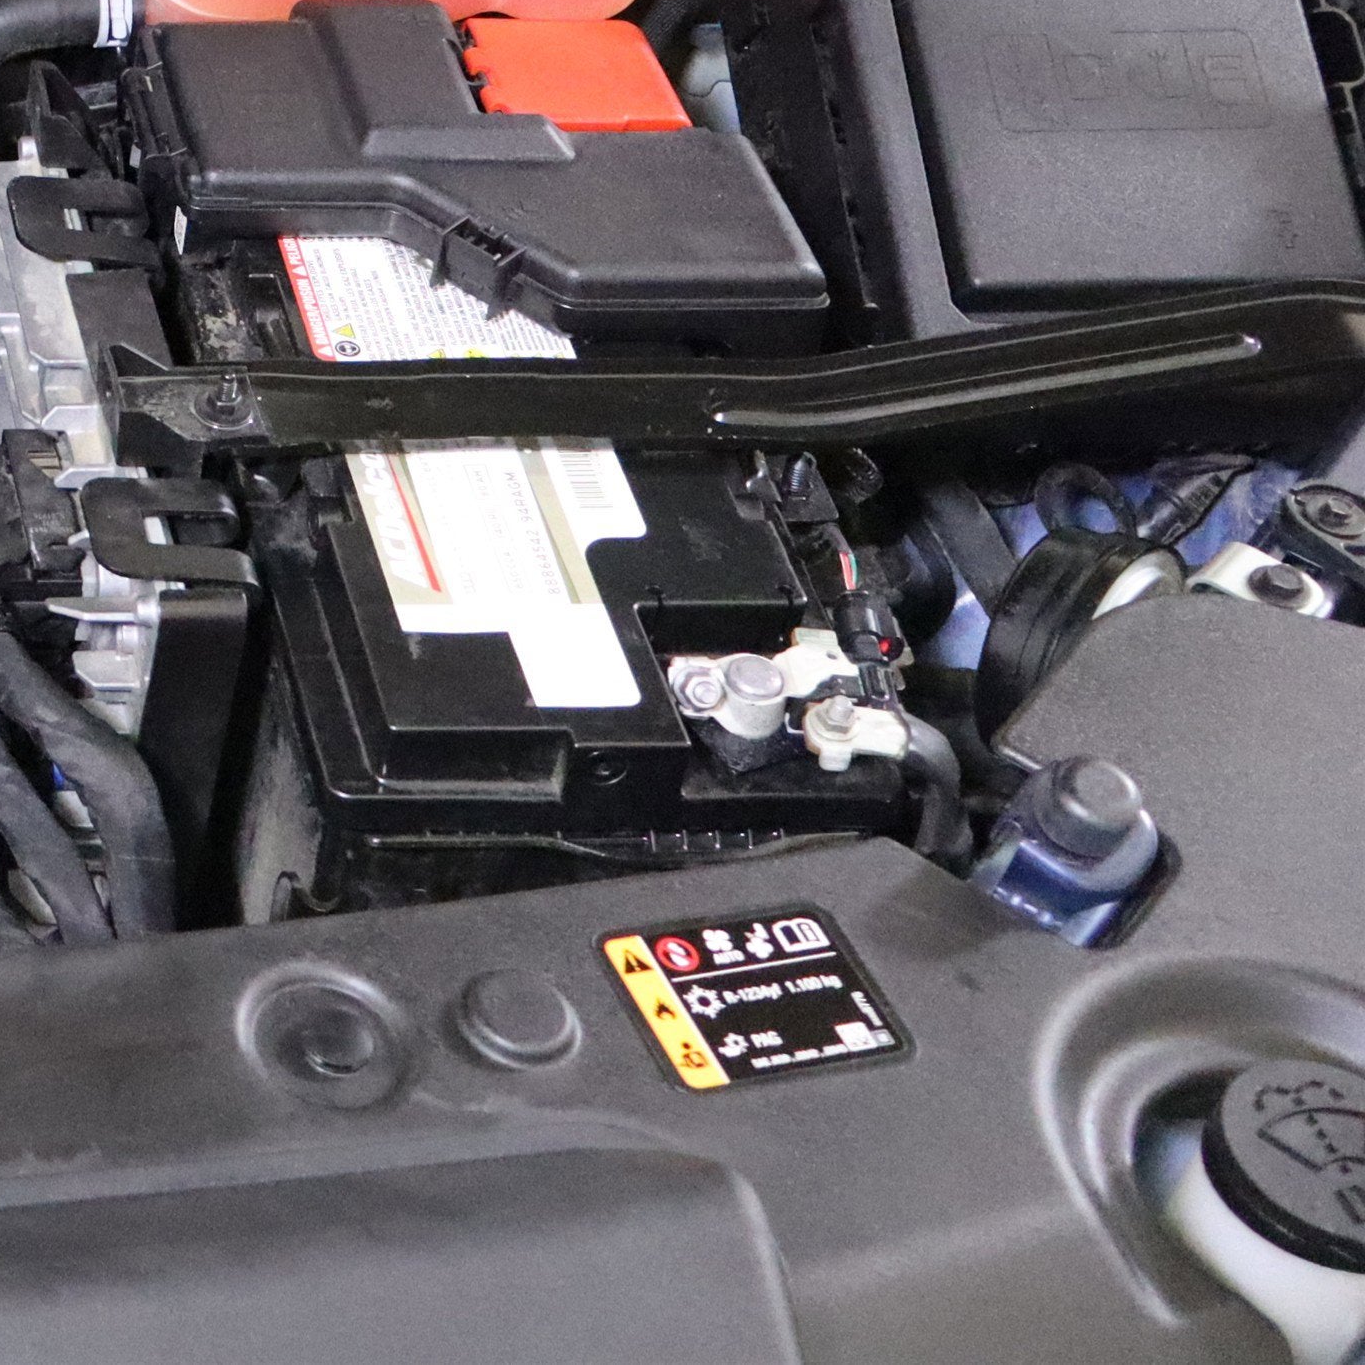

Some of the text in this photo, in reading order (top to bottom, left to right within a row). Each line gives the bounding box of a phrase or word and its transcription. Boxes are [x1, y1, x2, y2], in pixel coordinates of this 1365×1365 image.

[283, 238, 329, 344] DANGER/POISON PELIGR
[526, 529, 561, 595] 88864542
[749, 1030, 784, 1049] PAG
